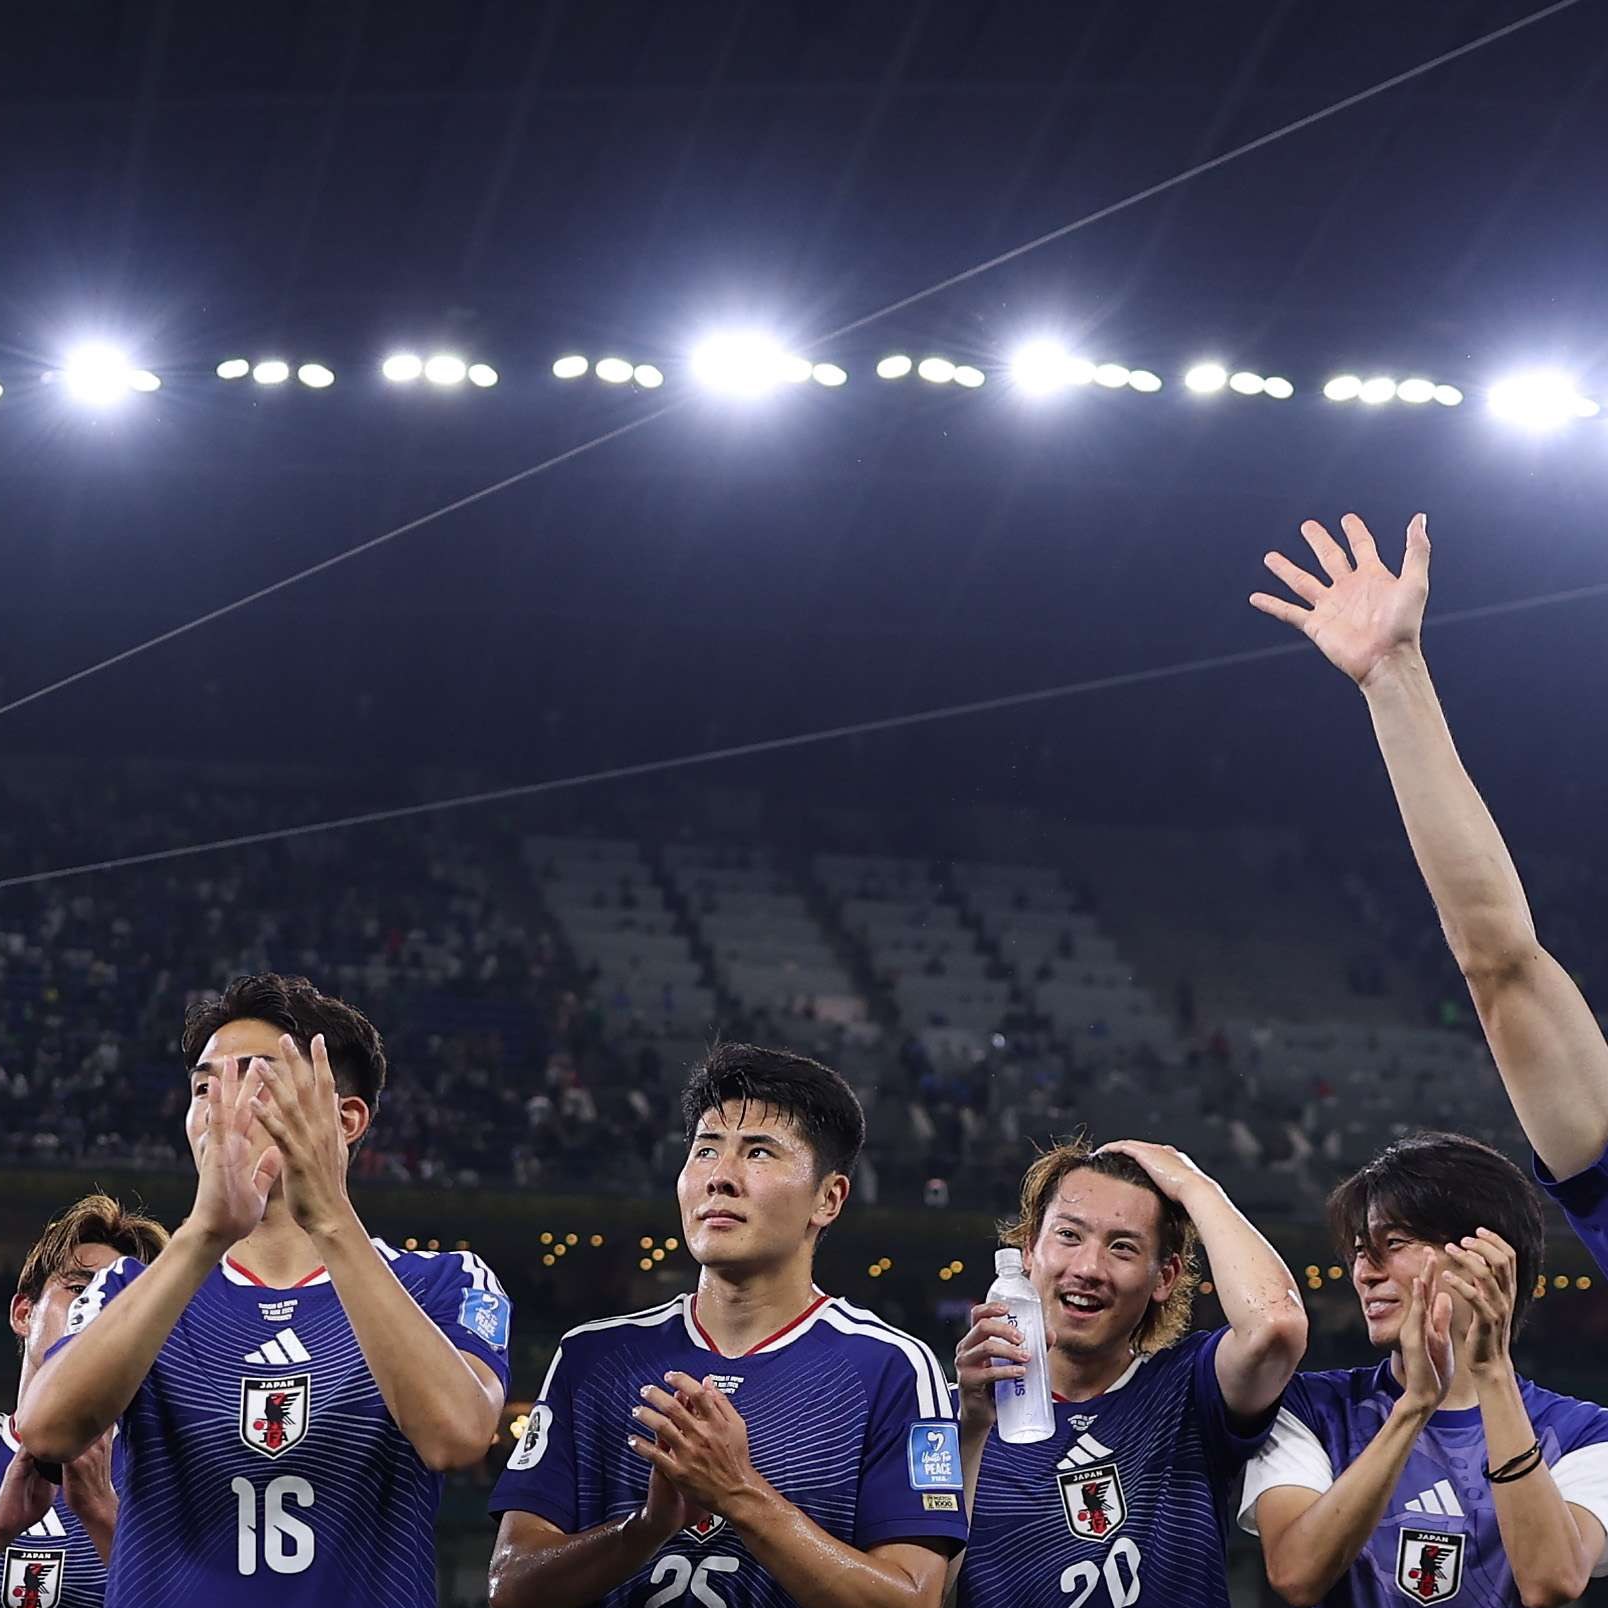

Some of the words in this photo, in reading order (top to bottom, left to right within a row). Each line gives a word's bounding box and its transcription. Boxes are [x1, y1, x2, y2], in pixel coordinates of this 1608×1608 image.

[259, 1380, 295, 1389] JAPAN
[924, 1463, 952, 1475] PEACE
[1072, 1470, 1104, 1482] JAPAN
[231, 1475, 315, 1576] 16
[1416, 1532, 1450, 1543] JAPAN
[20, 1552, 51, 1560] JAPAN
